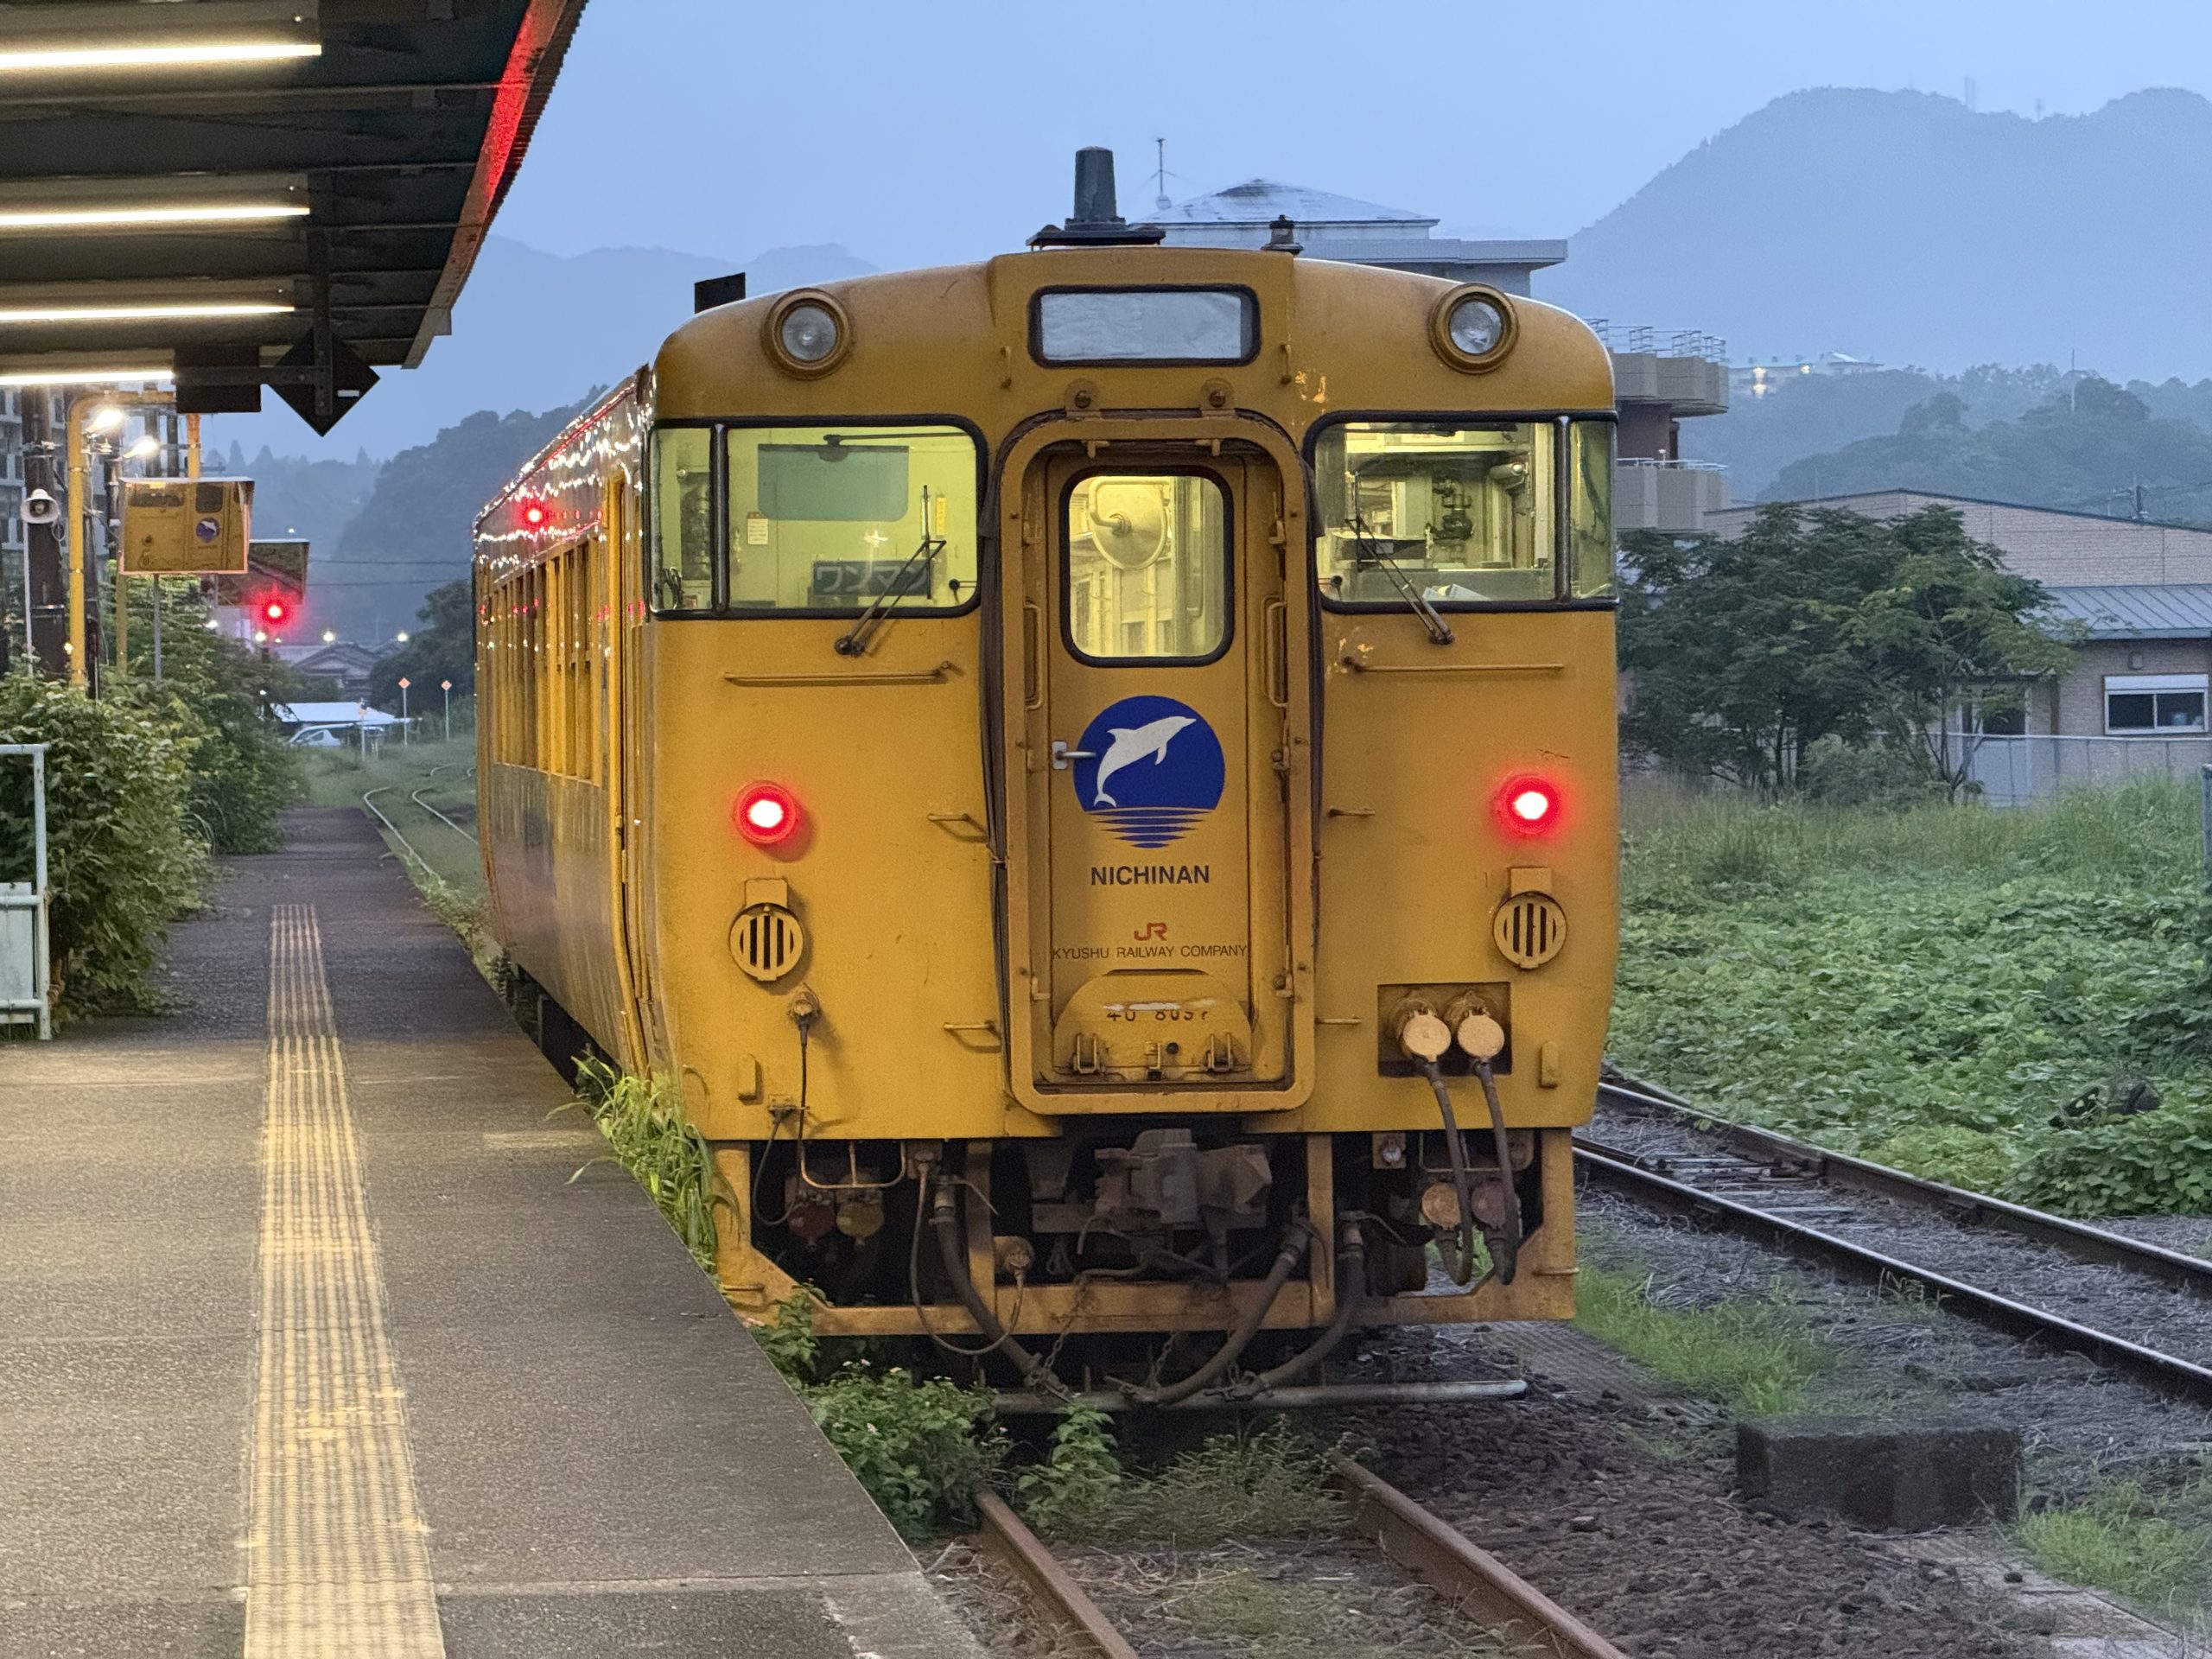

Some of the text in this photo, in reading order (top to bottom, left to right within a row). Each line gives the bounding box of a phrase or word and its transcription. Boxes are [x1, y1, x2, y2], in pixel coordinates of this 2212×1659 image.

[815, 563, 929, 594] ワンマン
[1090, 865, 1210, 885] NICHINAN
[1134, 922, 1167, 941] JR
[1052, 944, 1248, 960] KYUSHU RAILWAY COMPANY
